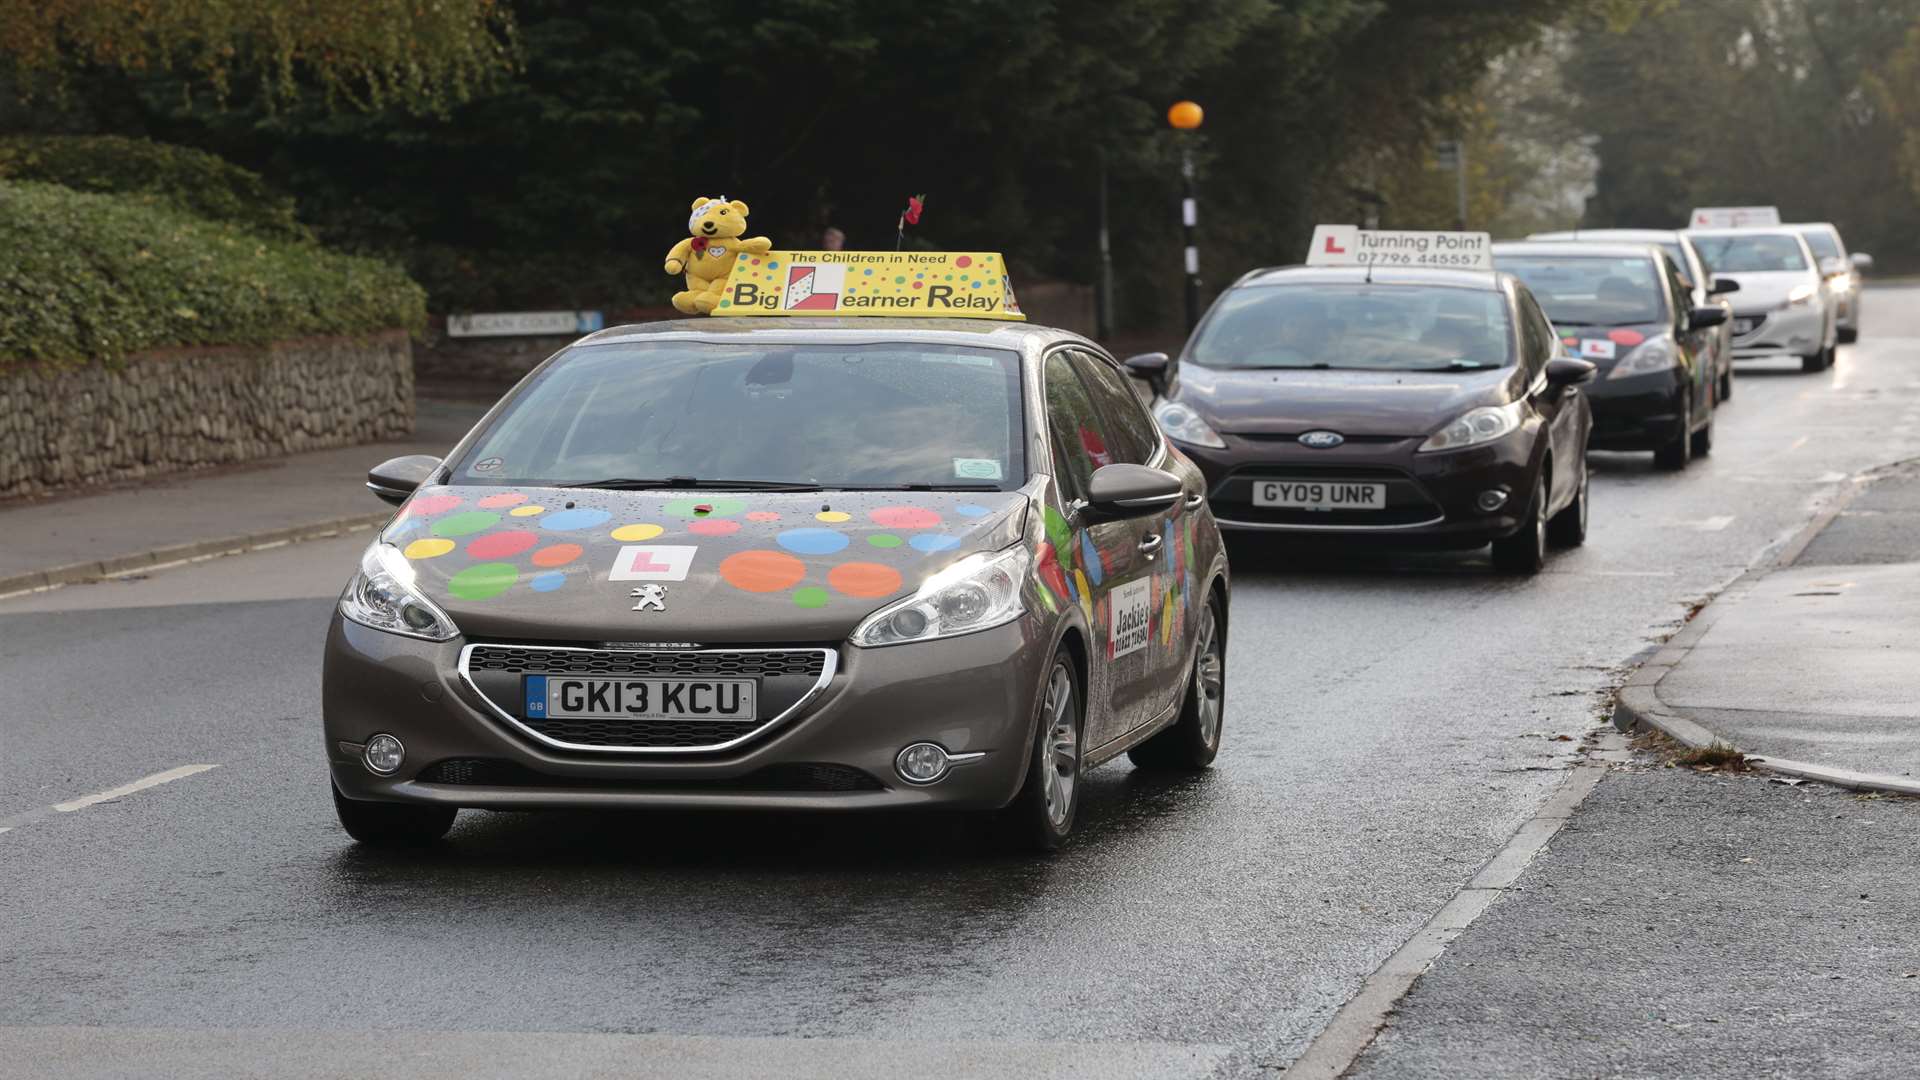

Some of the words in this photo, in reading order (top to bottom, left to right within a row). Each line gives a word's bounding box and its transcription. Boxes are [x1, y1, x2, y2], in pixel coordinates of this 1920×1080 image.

[1325, 237, 1345, 253] L
[1360, 234, 1429, 251] Turning
[1436, 235, 1482, 249] Point
[789, 253, 817, 264] The
[821, 253, 885, 264] Children
[888, 254, 904, 264] in
[907, 254, 947, 264] Need
[1357, 252, 1411, 264] 07796
[1417, 254, 1482, 265] 445557
[733, 283, 779, 310] Big
[927, 285, 1000, 312] Relay
[1264, 483, 1323, 502] GY09
[1330, 485, 1375, 503] UNR
[630, 551, 671, 573] L
[1116, 601, 1149, 636] Jackie's
[530, 702, 544, 711] GB
[561, 681, 649, 713] GK13
[661, 682, 740, 714] KCU
